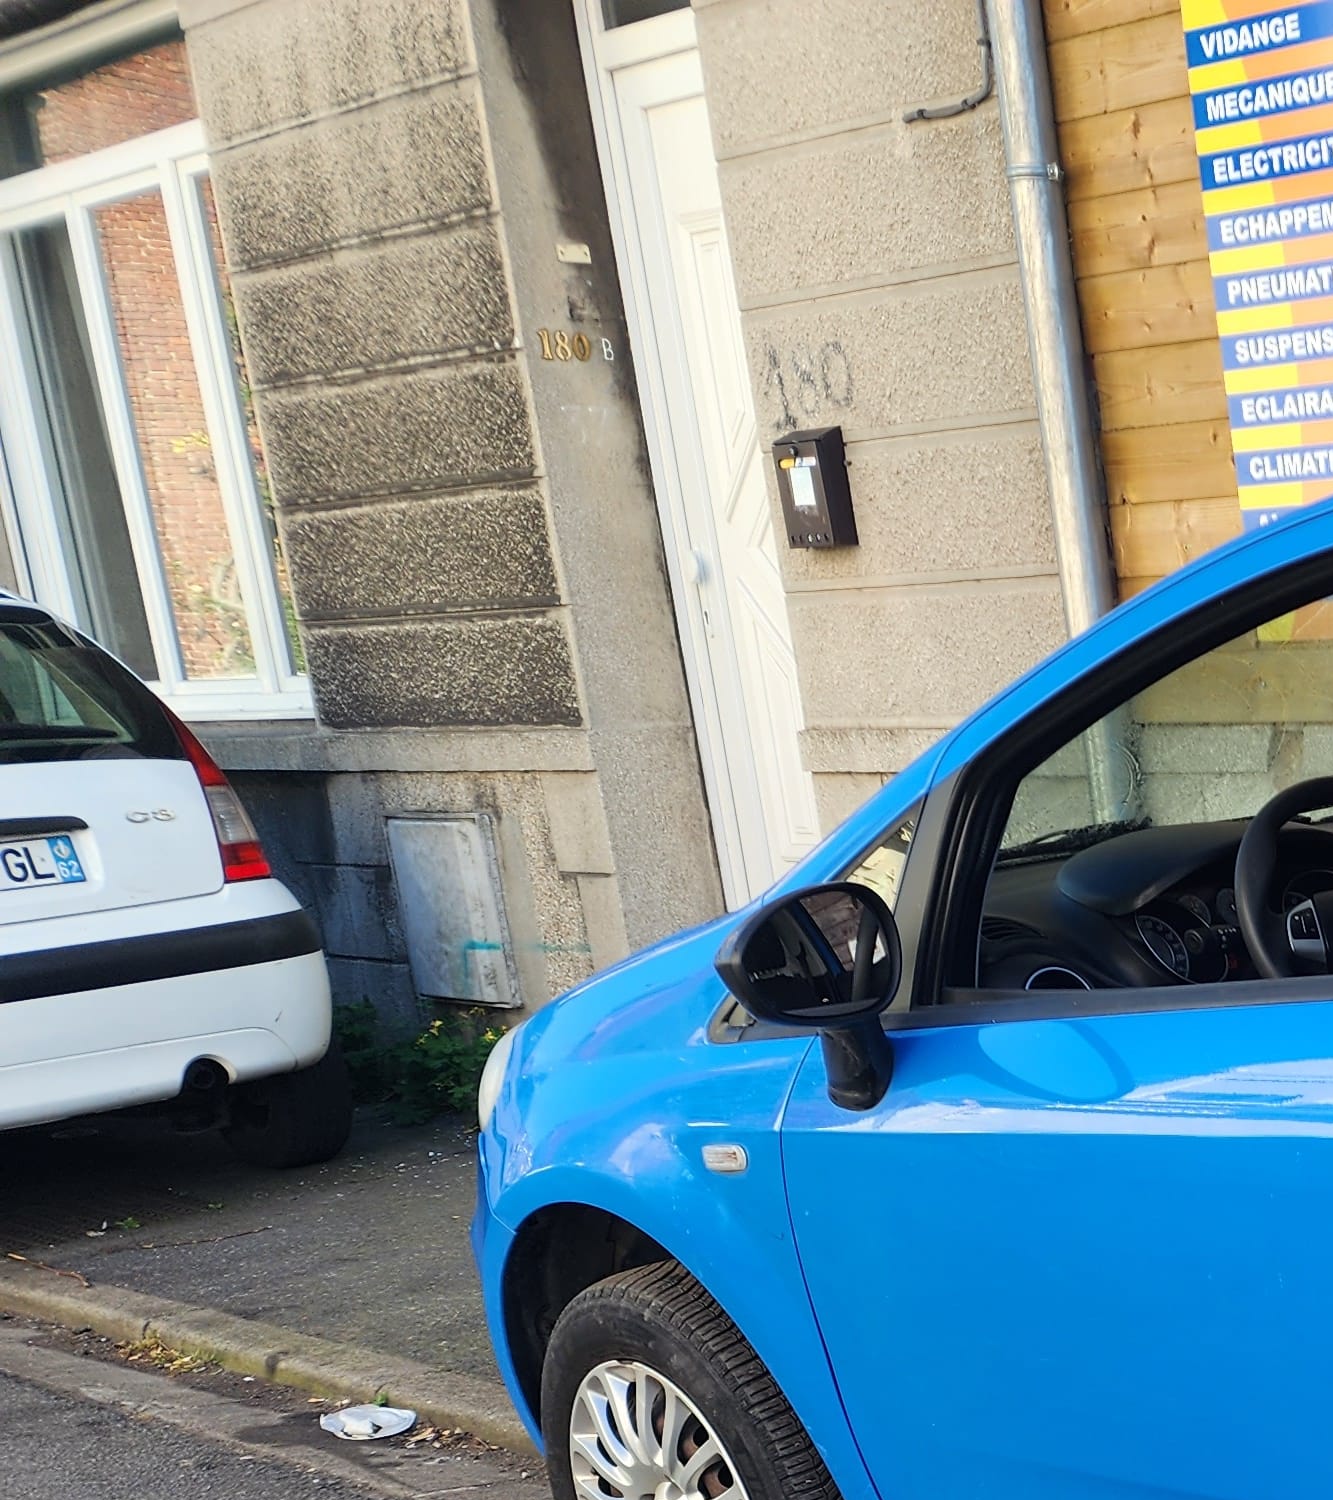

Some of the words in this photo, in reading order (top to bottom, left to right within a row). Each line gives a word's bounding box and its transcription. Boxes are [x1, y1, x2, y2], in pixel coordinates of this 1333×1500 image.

[1200, 13, 1300, 58] VIDANGE
[537, 328, 591, 361] 180
[601, 338, 614, 361] B
[0, 847, 56, 882] GL
[58, 860, 82, 878] 62
